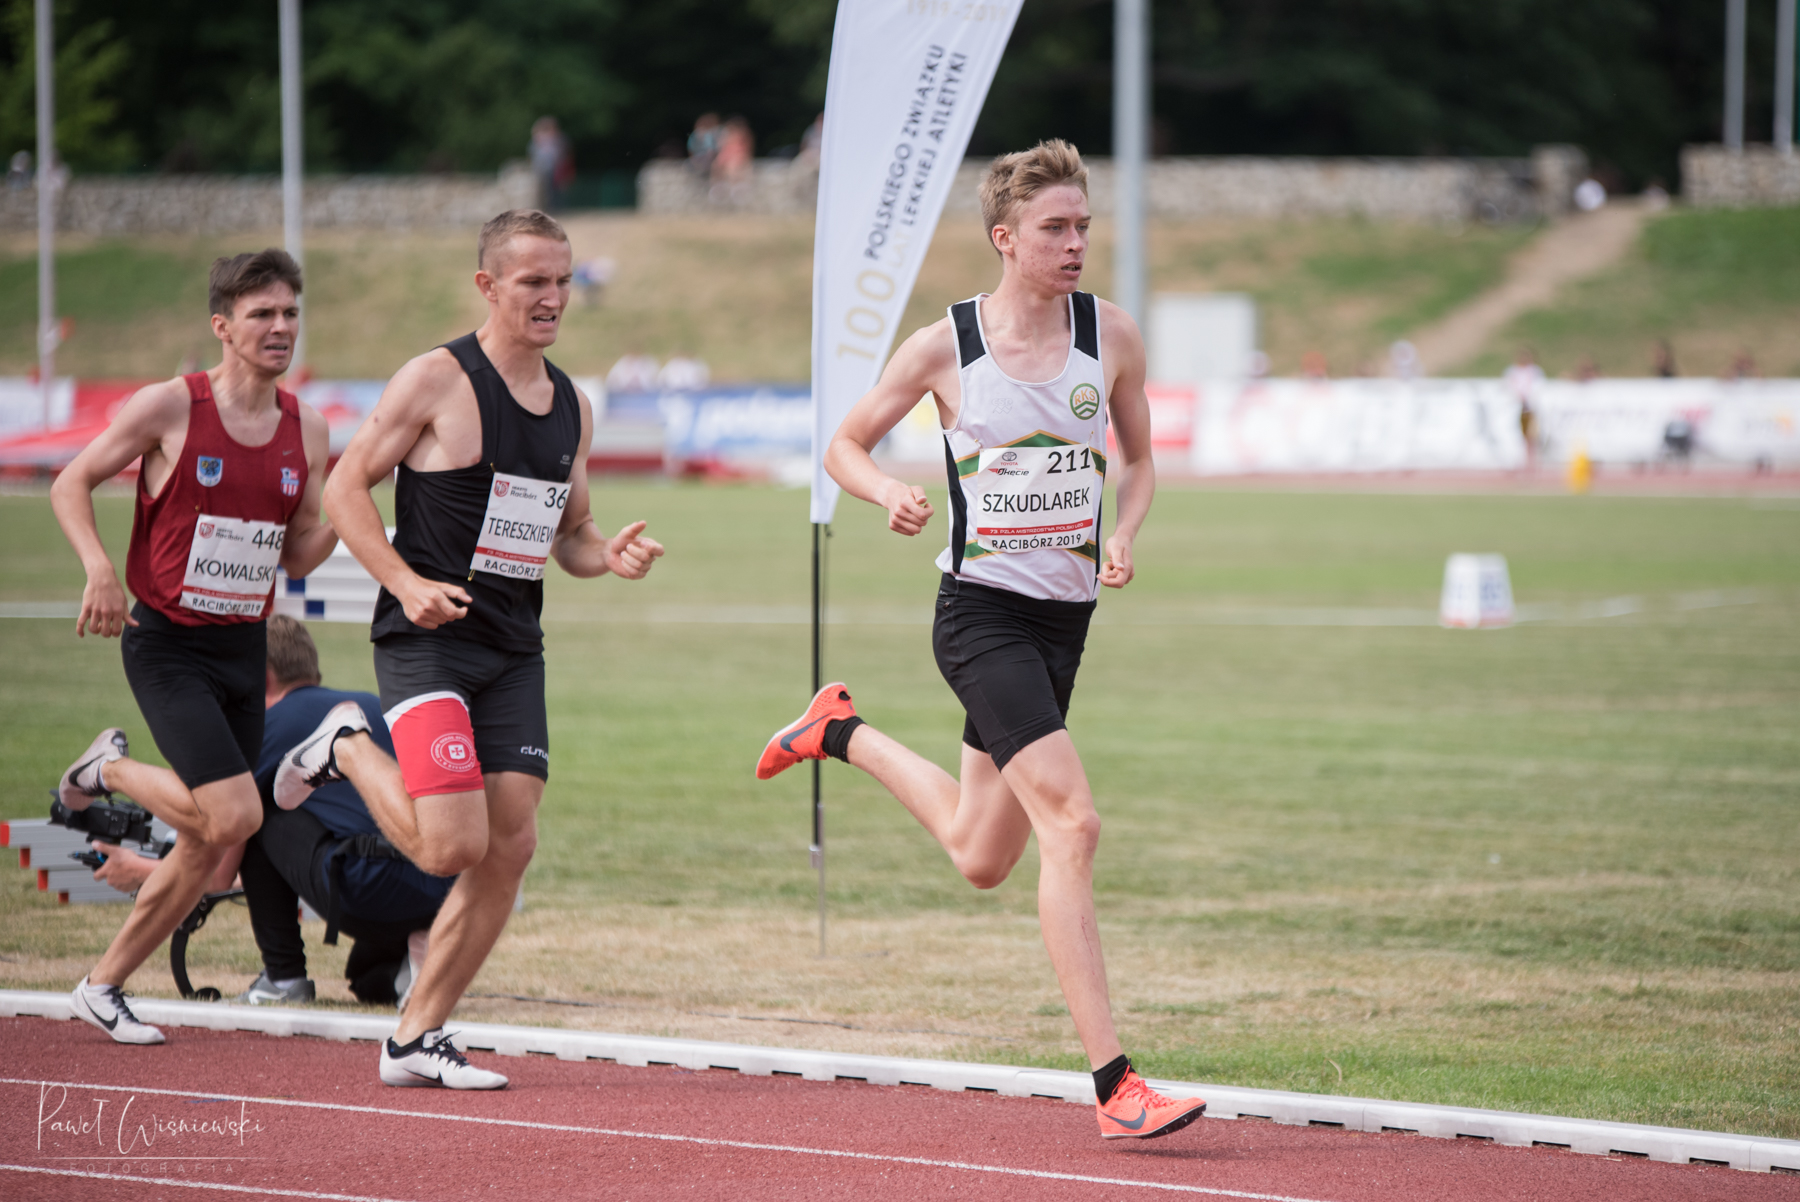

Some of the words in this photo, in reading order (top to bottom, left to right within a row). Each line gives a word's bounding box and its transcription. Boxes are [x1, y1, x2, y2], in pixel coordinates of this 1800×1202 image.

[900, 148, 938, 228] LEKKIEJ
[930, 52, 969, 144] ATLETYKI
[864, 141, 913, 261] POLSKIEGO
[901, 44, 946, 139] ZWIĄZKU
[836, 267, 896, 363] 100
[1074, 388, 1096, 406] RKS
[1047, 447, 1091, 475] 211
[544, 487, 568, 510] 36
[982, 487, 1090, 513] SZKUDLAREK
[252, 528, 285, 550] 448
[991, 536, 1053, 550] RACIBÓRZ
[1056, 533, 1082, 547] 2019
[194, 557, 276, 583] KOWALSKI
[484, 559, 536, 578] RACIBÓRZ
[192, 597, 241, 613] RACIBÓRZ
[242, 602, 261, 614] 2019
